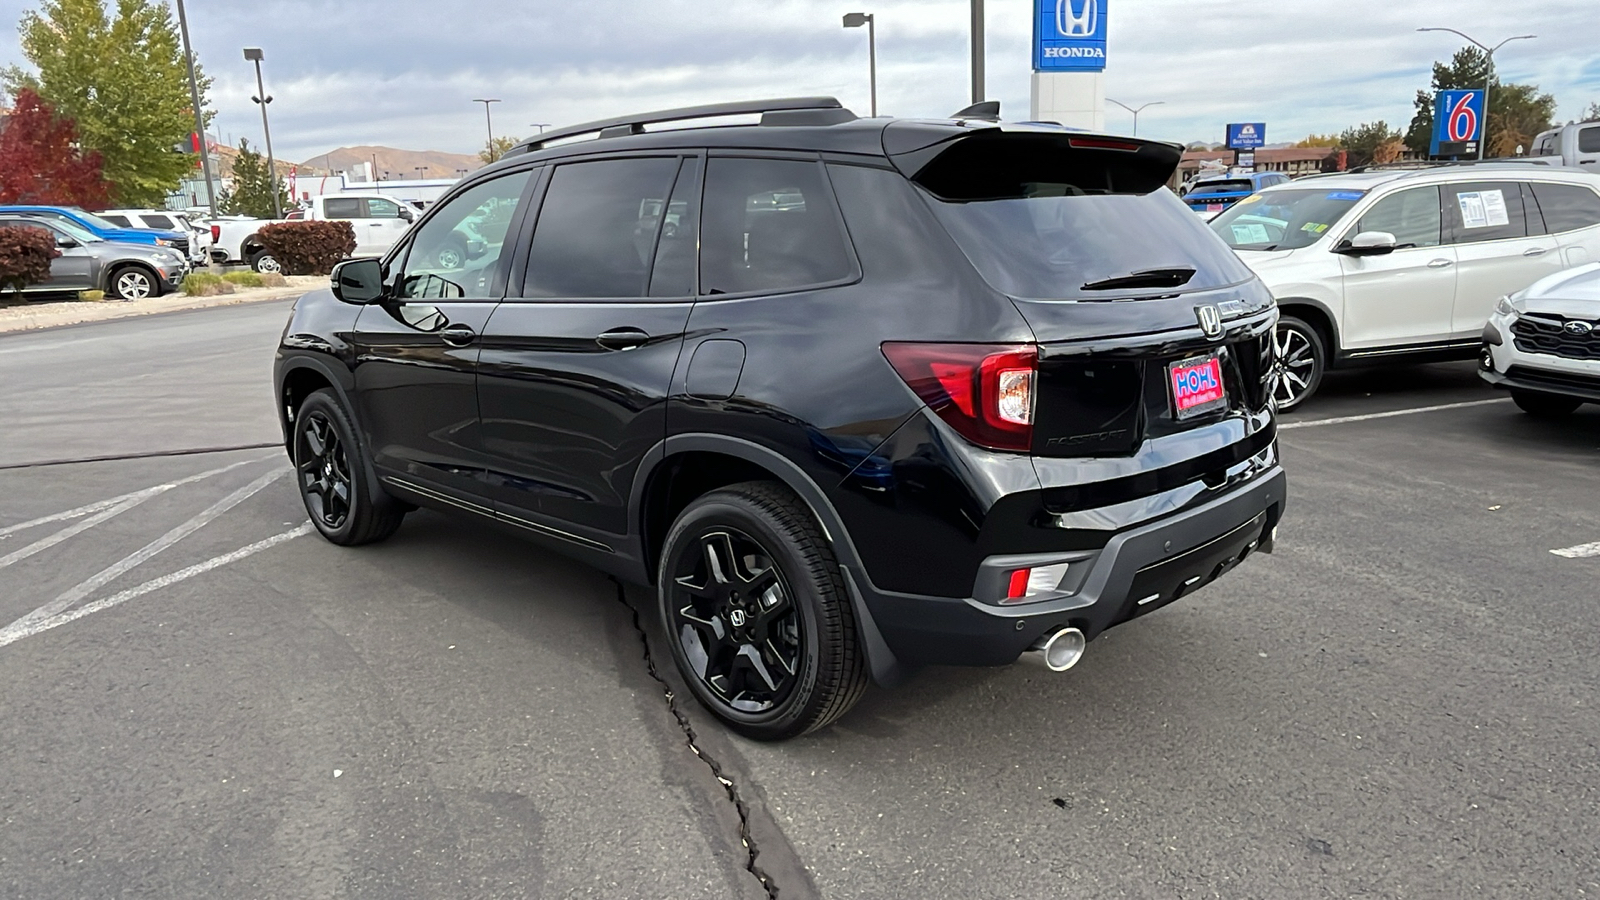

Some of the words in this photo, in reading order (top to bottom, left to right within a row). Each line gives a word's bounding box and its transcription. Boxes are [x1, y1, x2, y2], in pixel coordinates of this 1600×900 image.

[1043, 47, 1105, 58] HONDA
[1447, 92, 1477, 142] 6
[1175, 364, 1217, 398] HOHL
